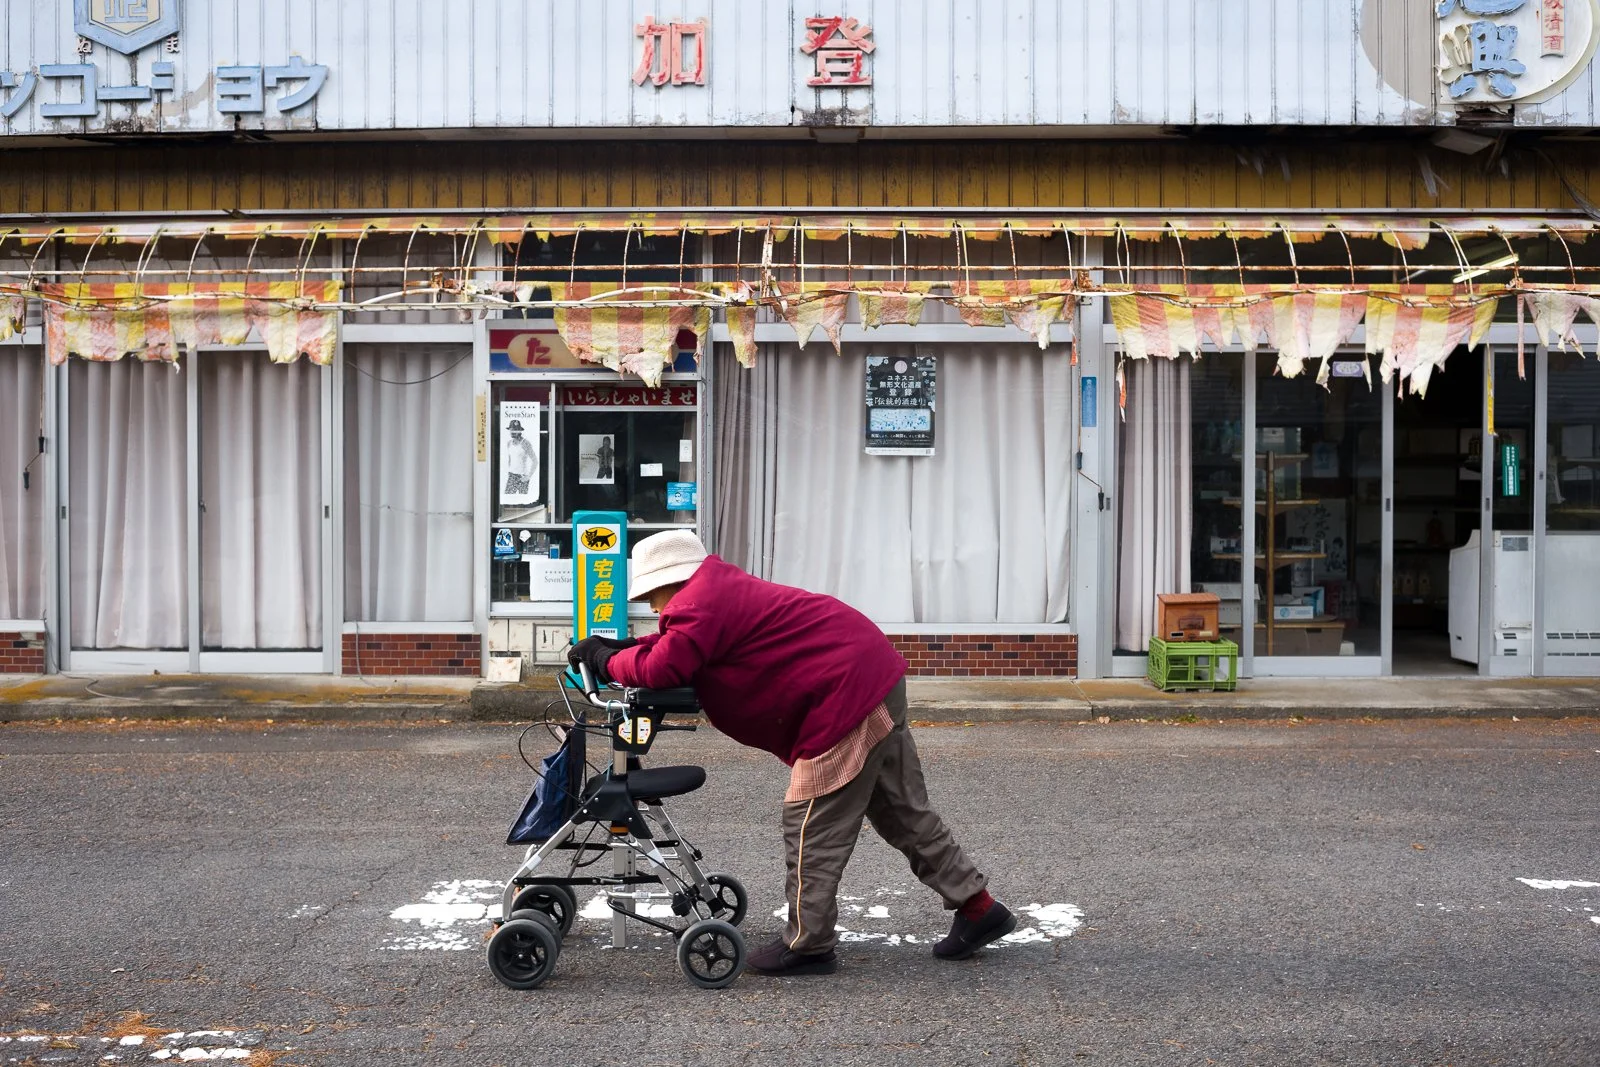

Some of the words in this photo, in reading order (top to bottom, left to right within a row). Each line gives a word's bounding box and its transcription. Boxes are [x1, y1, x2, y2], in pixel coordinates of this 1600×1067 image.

[568, 388, 695, 405] いらっしゃいませ
[592, 558, 615, 623] 宅急便
